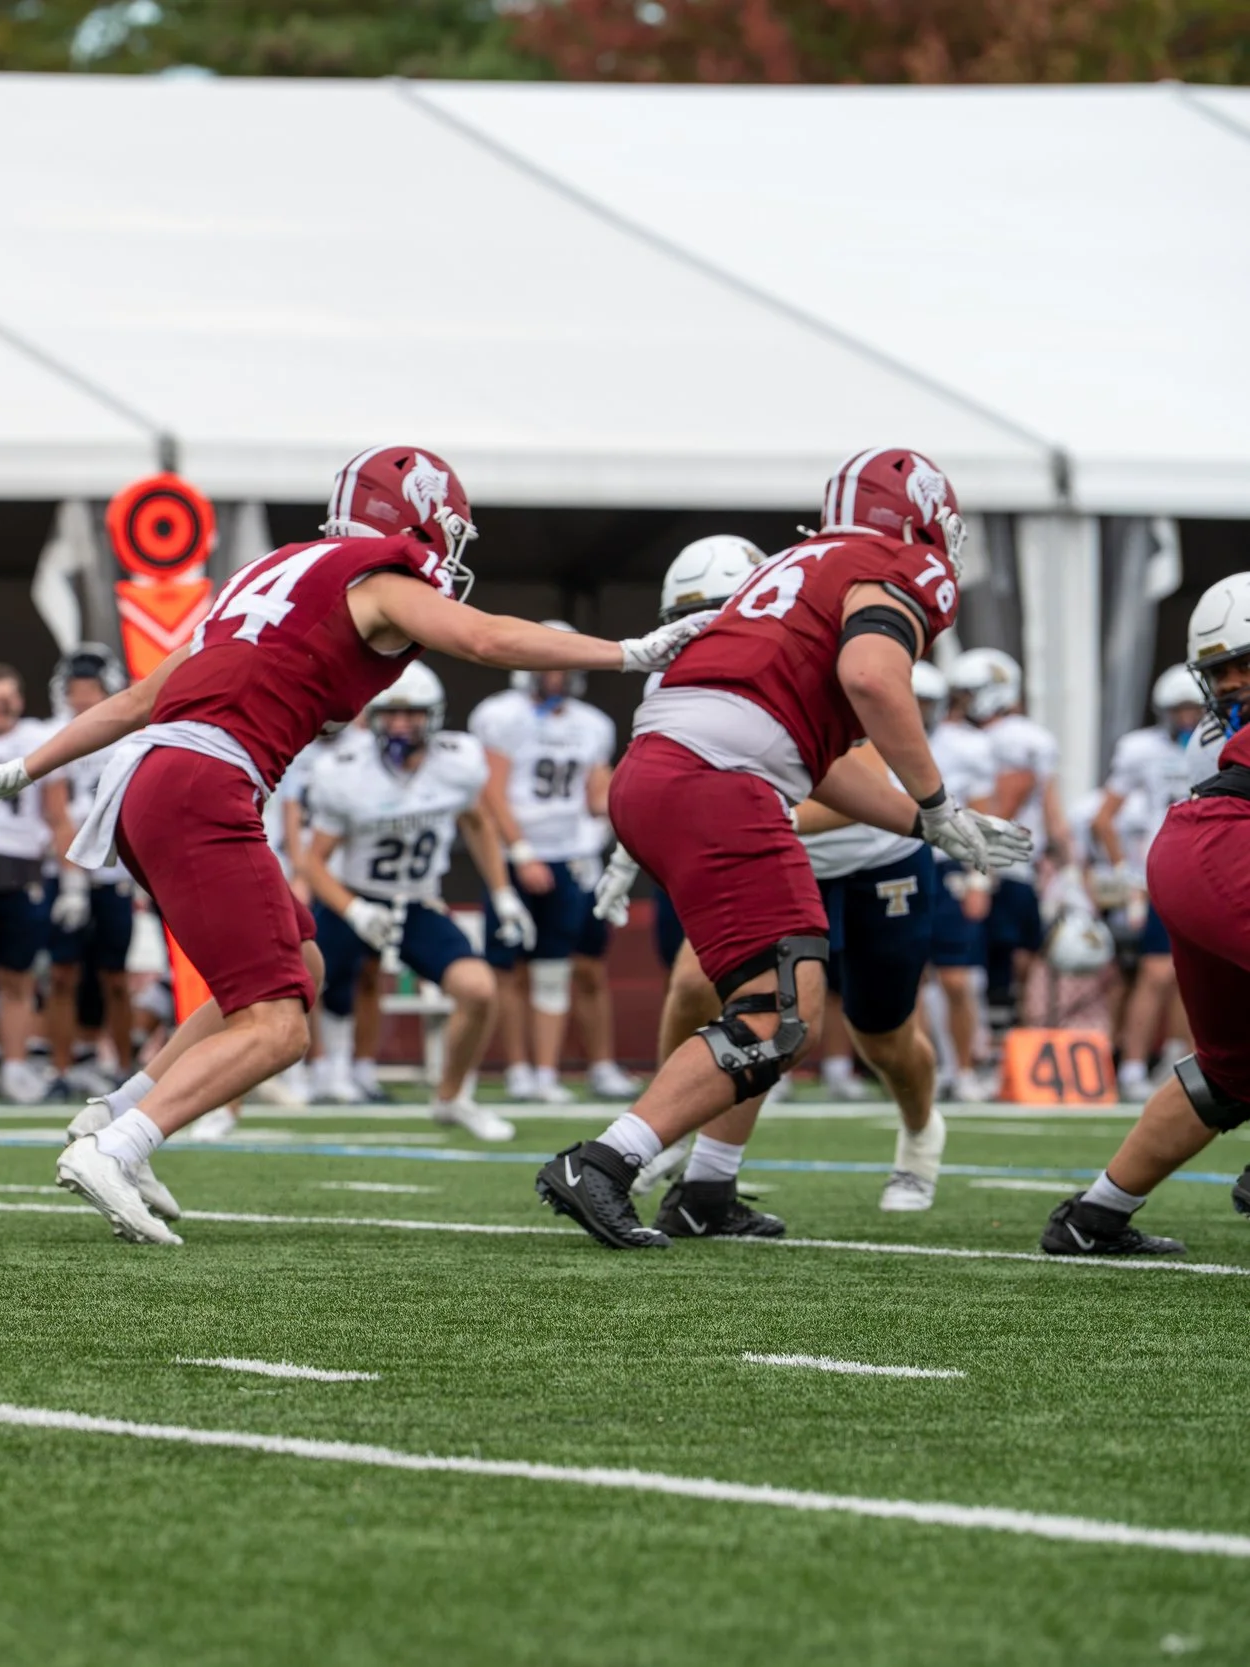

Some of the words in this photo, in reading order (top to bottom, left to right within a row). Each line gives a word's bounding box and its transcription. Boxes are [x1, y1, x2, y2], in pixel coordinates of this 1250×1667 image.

[189, 542, 342, 656] 14
[914, 552, 957, 614] 76
[875, 875, 919, 917] T
[1030, 1040, 1105, 1102] 40
